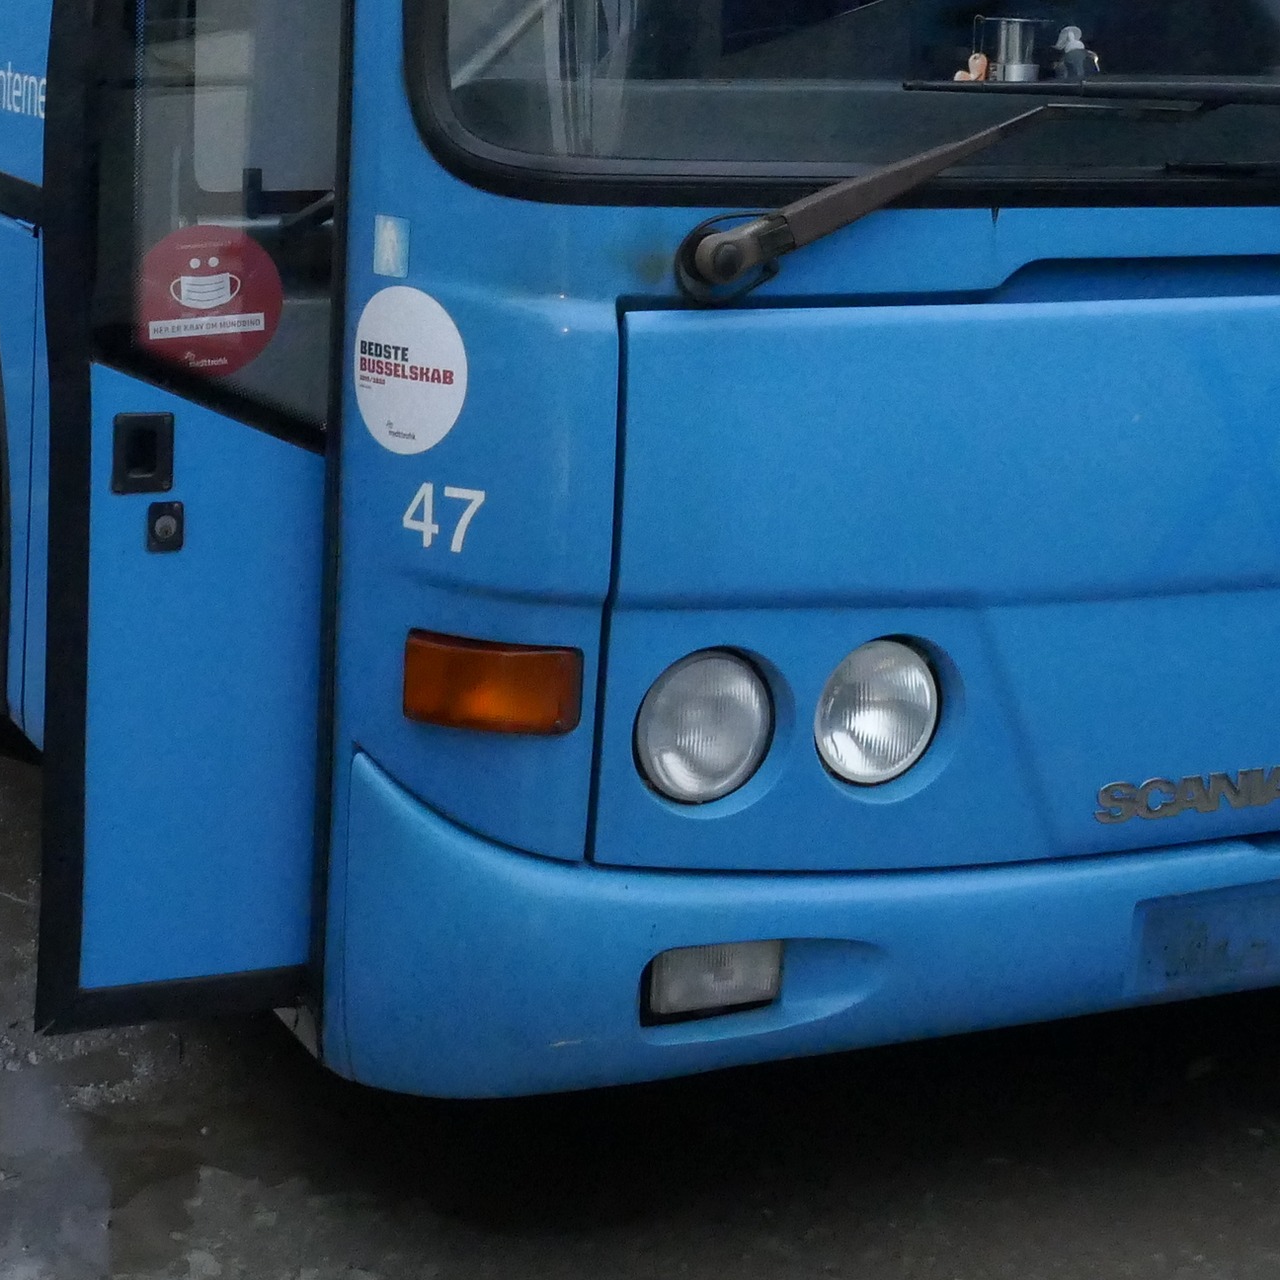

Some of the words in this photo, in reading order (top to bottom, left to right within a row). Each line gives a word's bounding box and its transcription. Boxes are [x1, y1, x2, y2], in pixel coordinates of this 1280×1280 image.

[360, 339, 409, 363] BEDSTE
[359, 355, 455, 386] BUSSELSKAB
[402, 481, 486, 553] 47
